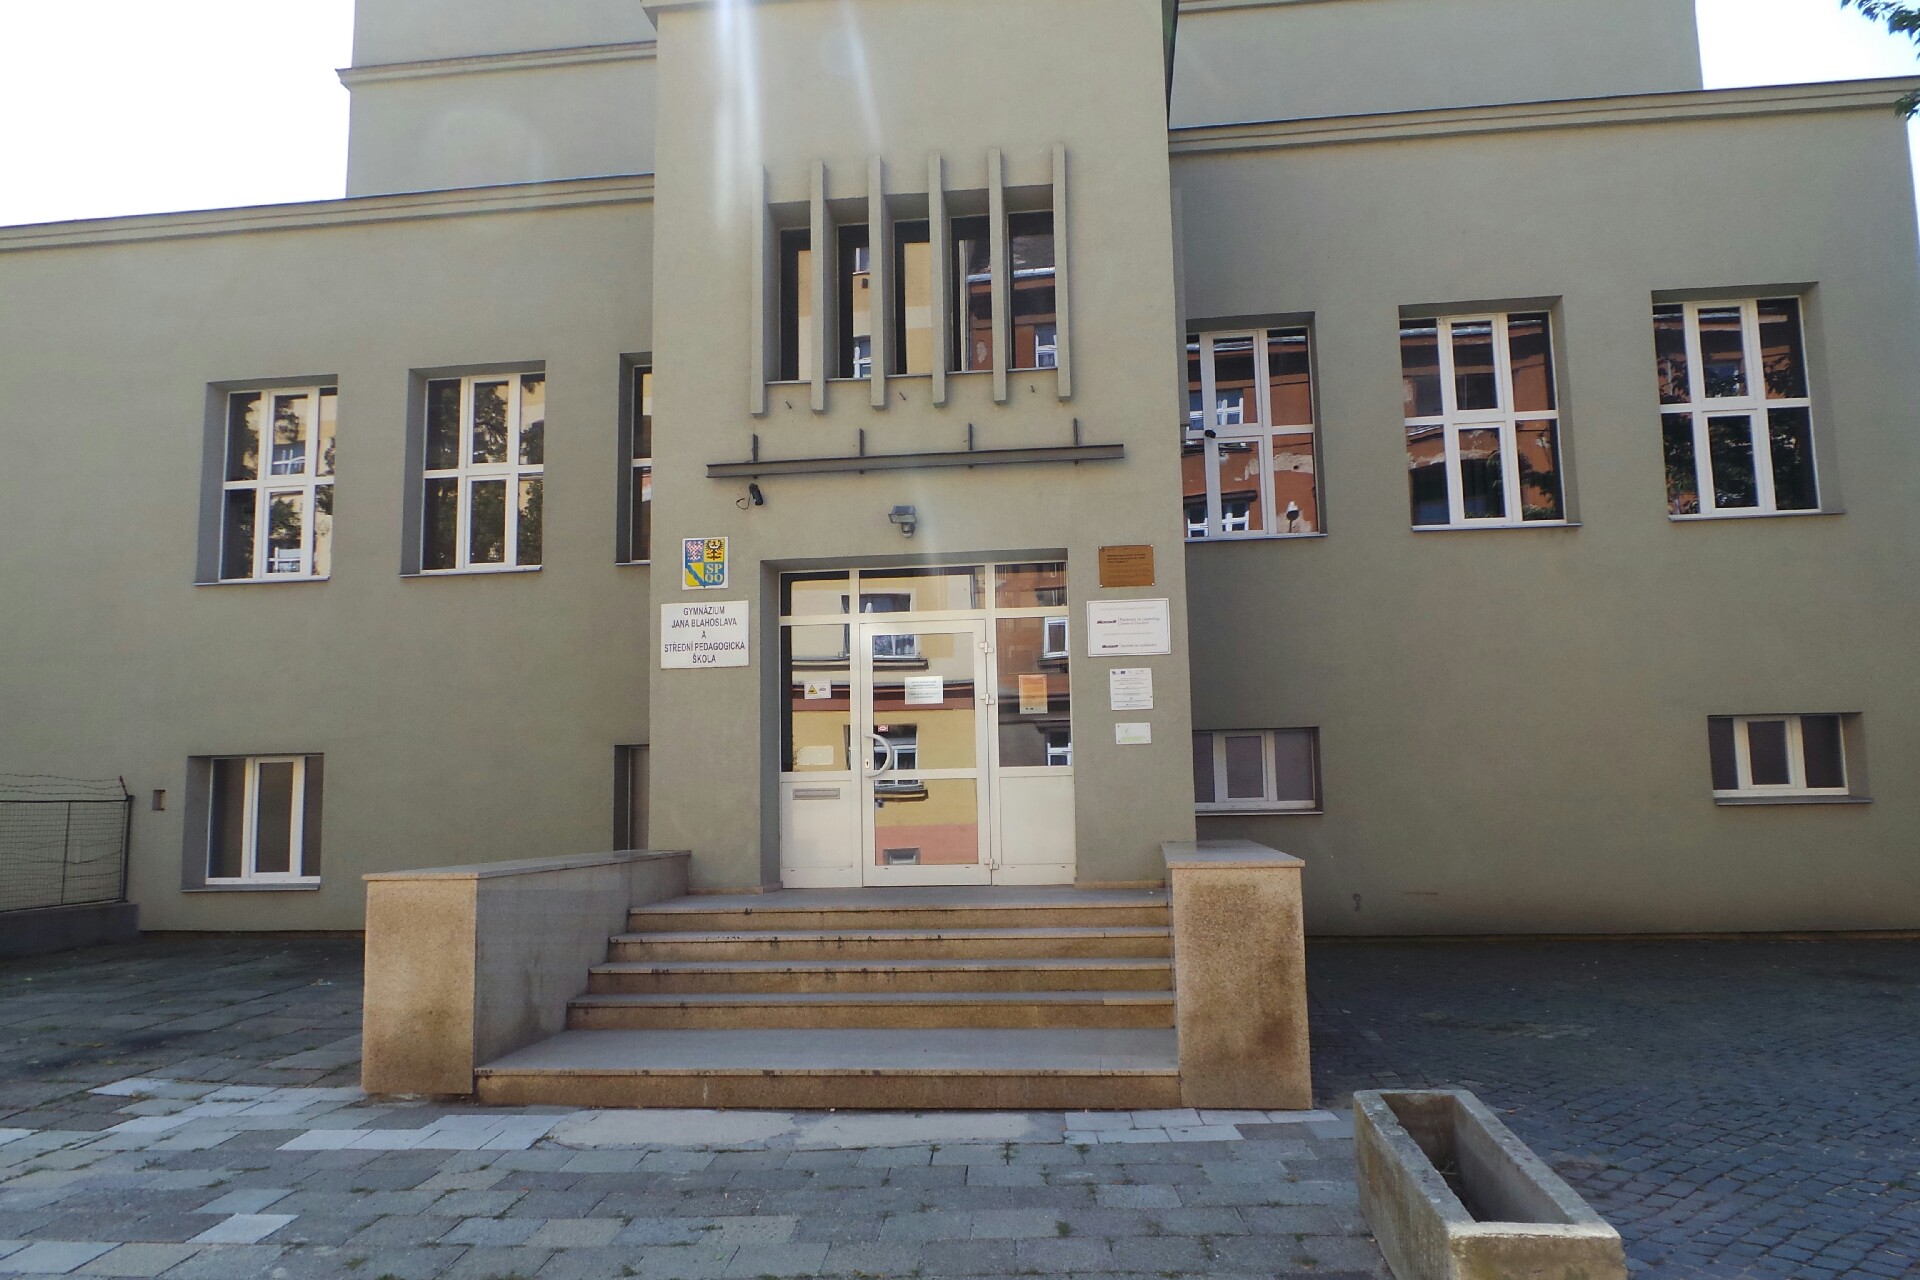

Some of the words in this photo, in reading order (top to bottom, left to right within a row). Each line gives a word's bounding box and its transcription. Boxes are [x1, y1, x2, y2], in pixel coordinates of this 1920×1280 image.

[706, 563, 722, 574] SP
[683, 605, 725, 616] GYMNÁZIUM
[671, 619, 690, 628] JANA
[691, 617, 737, 627] BLAHOSLAVA
[701, 630, 707, 639] A
[664, 641, 694, 653] STŘEDNÍ
[692, 653, 717, 664] ŠKOLA
